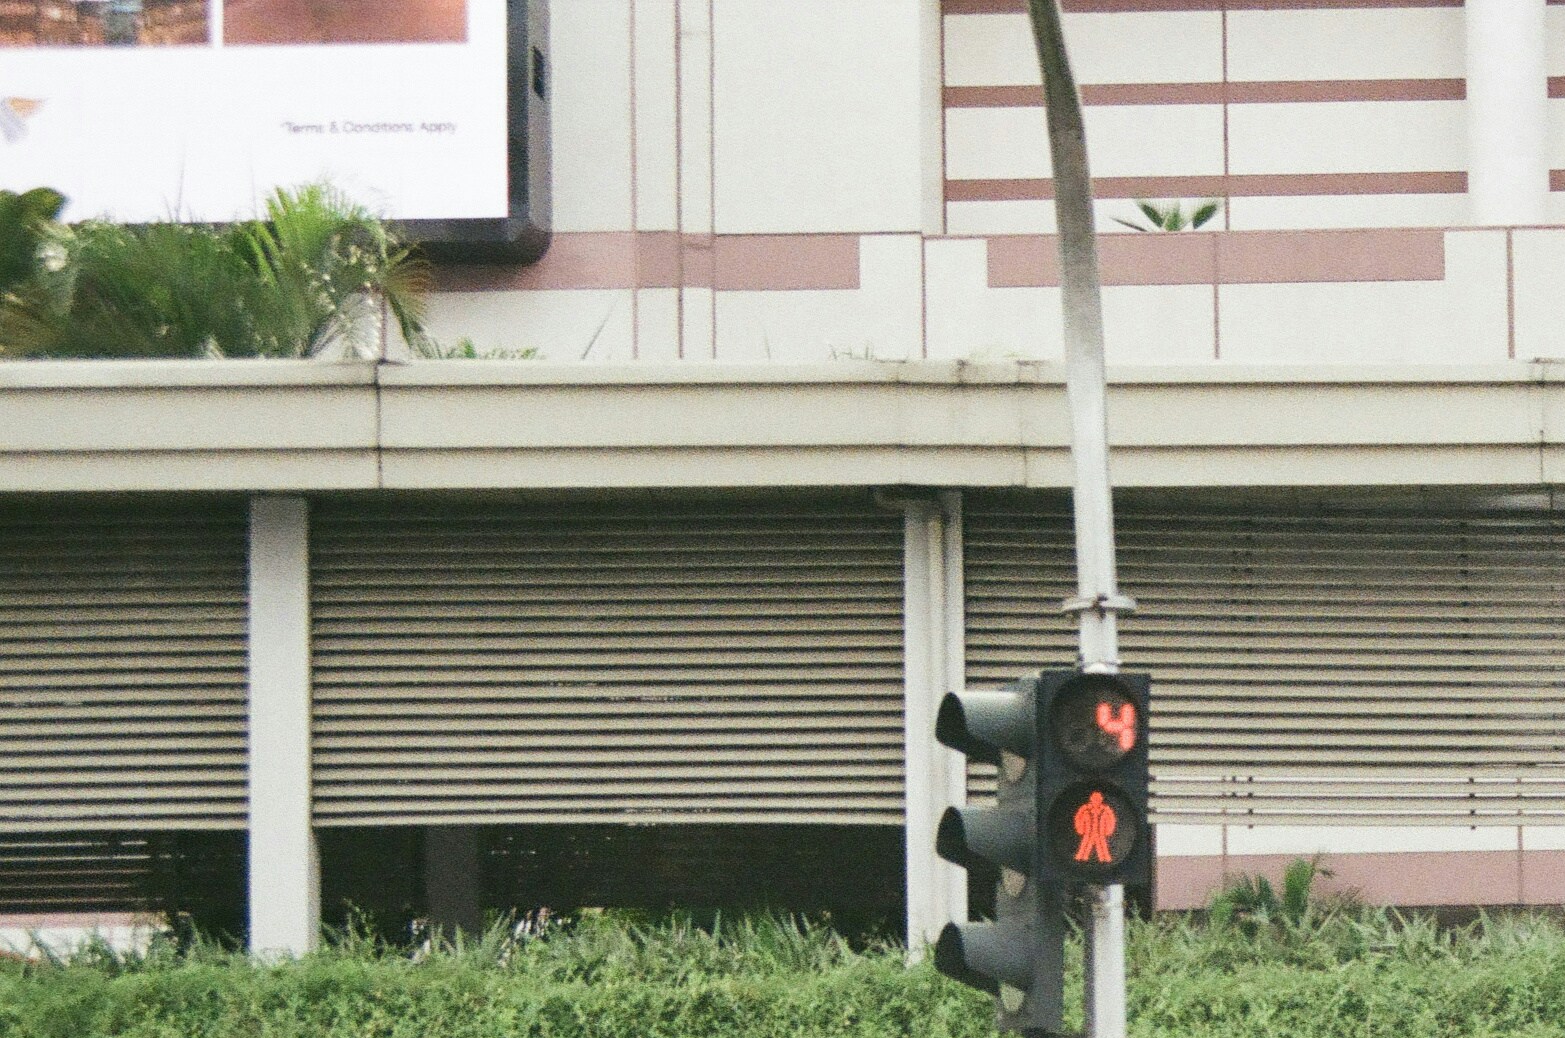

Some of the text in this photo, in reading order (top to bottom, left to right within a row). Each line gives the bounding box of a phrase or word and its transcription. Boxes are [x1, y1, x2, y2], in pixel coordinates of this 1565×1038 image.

[330, 120, 338, 134] &
[343, 120, 413, 133] Conditions
[421, 121, 456, 136] Apply
[1095, 702, 1136, 752] 4
